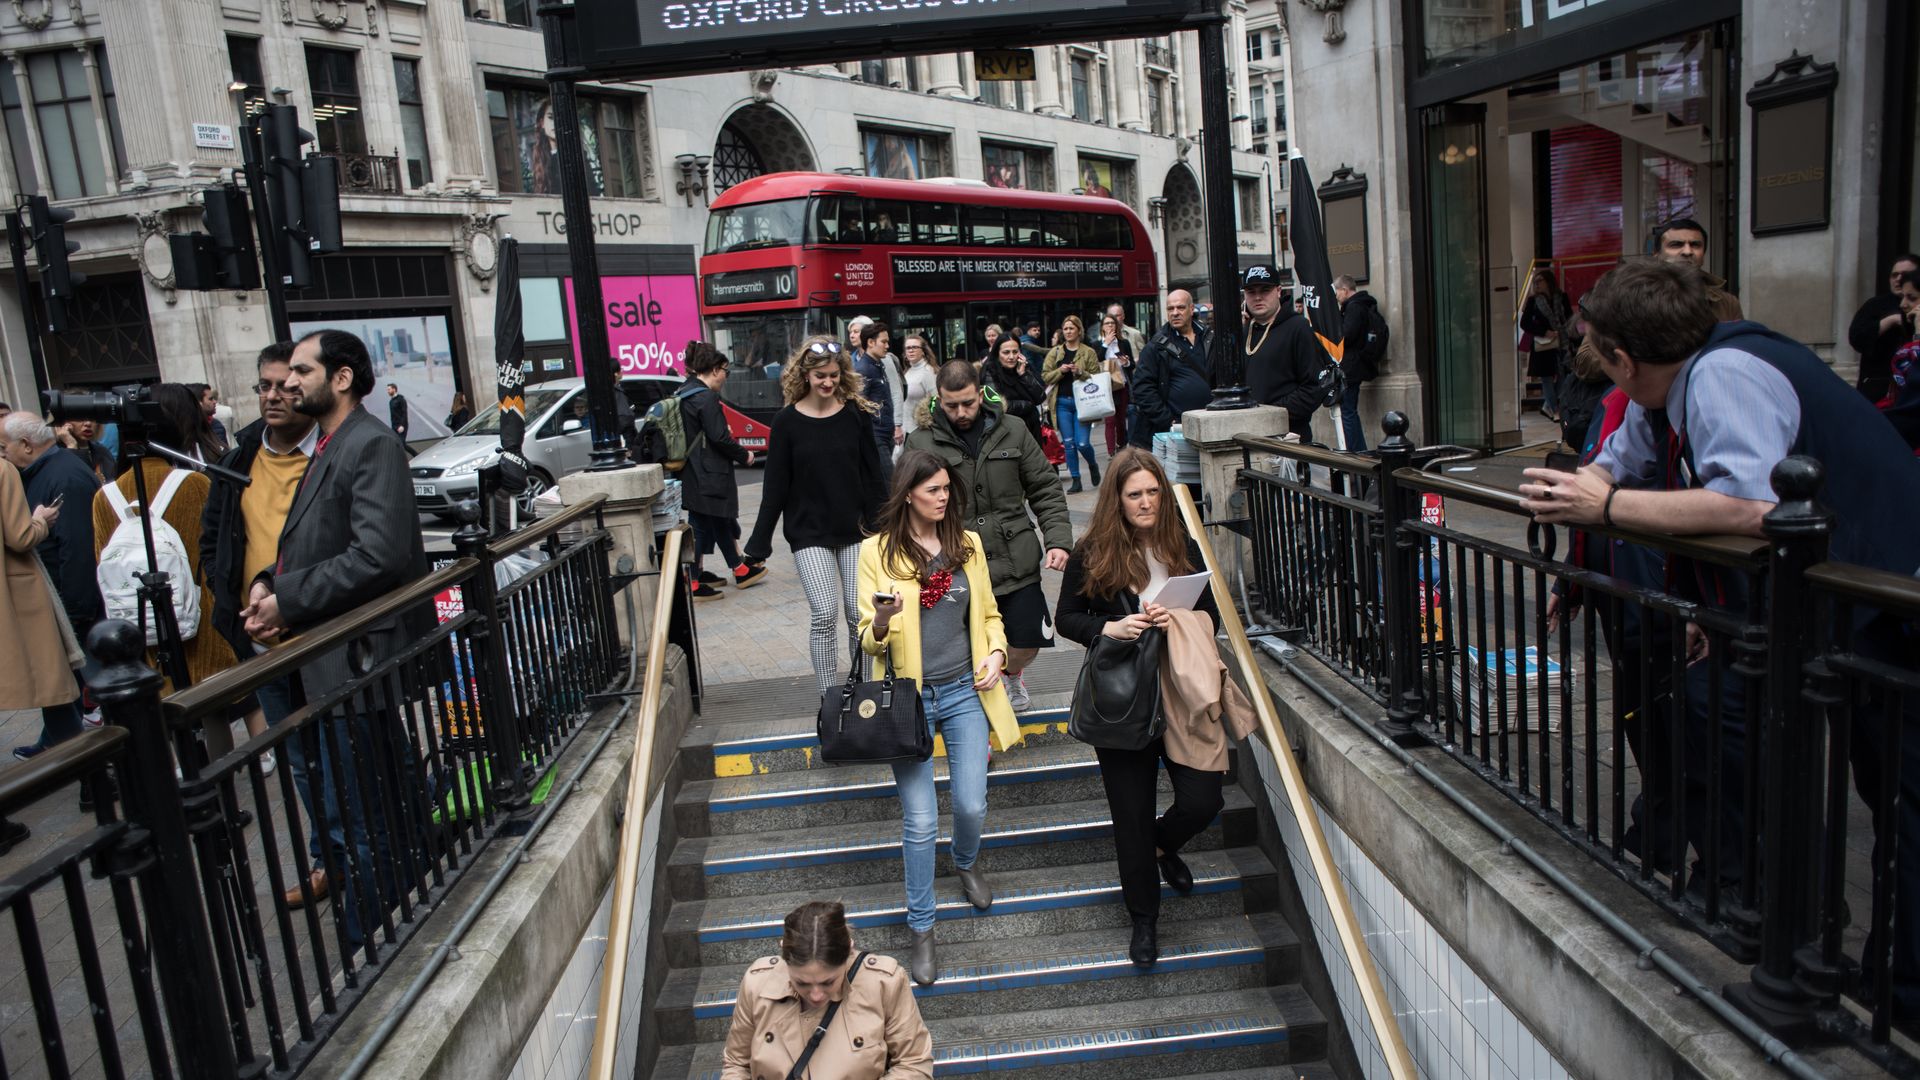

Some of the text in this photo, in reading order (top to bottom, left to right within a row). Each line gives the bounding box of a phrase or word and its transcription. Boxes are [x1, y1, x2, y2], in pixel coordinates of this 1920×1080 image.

[662, 0, 943, 29] OXFORD CIR
[981, 55, 1029, 75] RVP
[536, 211, 641, 236] TOSHOP
[845, 263, 874, 271] LONDON
[846, 272, 875, 280] UNITED
[938, 260, 956, 273] ARE
[956, 260, 974, 273] THE
[975, 260, 998, 273] MEEK
[999, 260, 1015, 273] FOR
[1016, 260, 1035, 273] THEY
[1036, 261, 1058, 273] SHALL
[1059, 261, 1084, 273] INHERIT
[1085, 262, 1098, 273] THE
[712, 274, 791, 296] Hammersmith 10
[608, 293, 663, 329] sale
[618, 341, 674, 372] 50%
